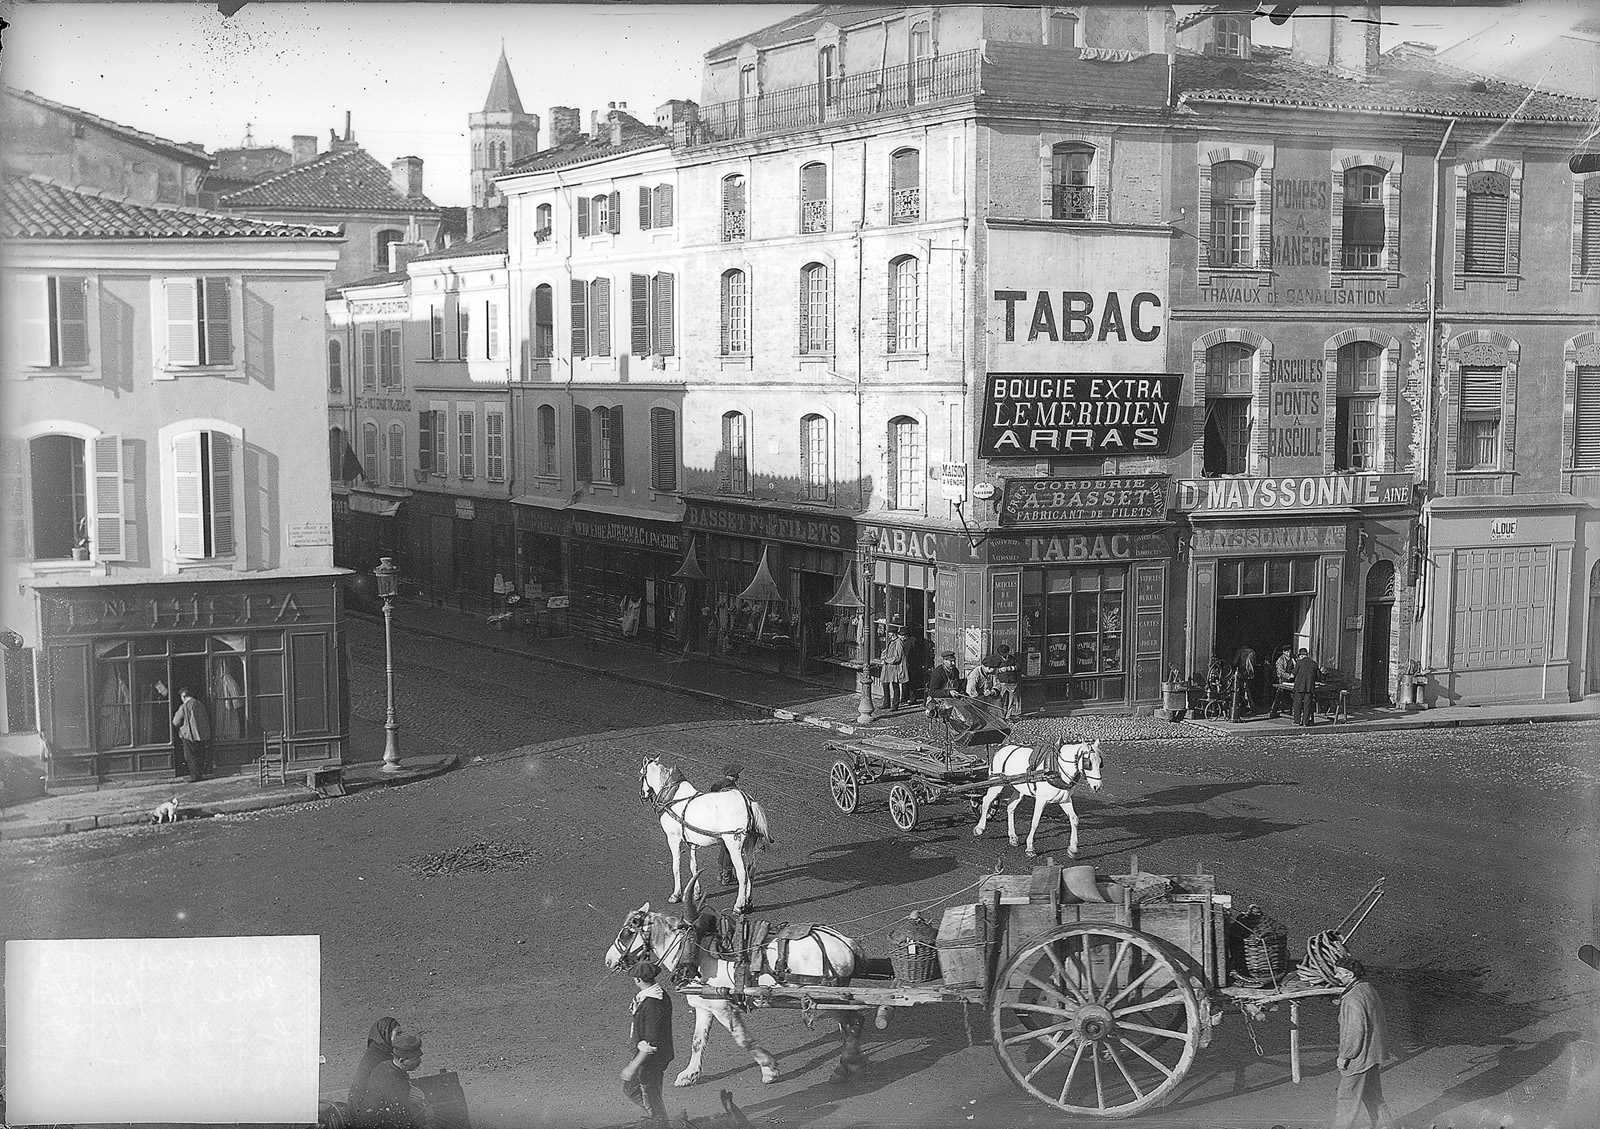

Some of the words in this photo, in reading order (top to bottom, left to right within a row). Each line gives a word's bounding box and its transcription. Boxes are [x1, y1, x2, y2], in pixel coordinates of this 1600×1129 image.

[1275, 179, 1326, 210] POMPES
[1201, 287, 1261, 304] TRAVAUX
[1286, 288, 1386, 305] CANALISATION
[994, 290, 1162, 342] TABAC
[1269, 359, 1323, 383] BASCULES
[993, 379, 1076, 399] BOUGIE
[1090, 379, 1163, 399] EXTRA
[1275, 391, 1320, 416] PONTS
[993, 428, 1159, 449] ARRAS
[1268, 427, 1322, 457] BASCULE
[1033, 479, 1147, 491] CORDERIE
[1207, 476, 1382, 510] MAYSSONNIE
[1006, 485, 1028, 515] GROS
[1050, 489, 1151, 508] BASSET
[689, 506, 745, 531] BASSET
[779, 518, 841, 545] FILETS
[1016, 509, 1085, 521] FABRICANT
[1091, 509, 1103, 519] DE
[1111, 506, 1152, 518] FILETS
[1024, 533, 1130, 561] TABAC
